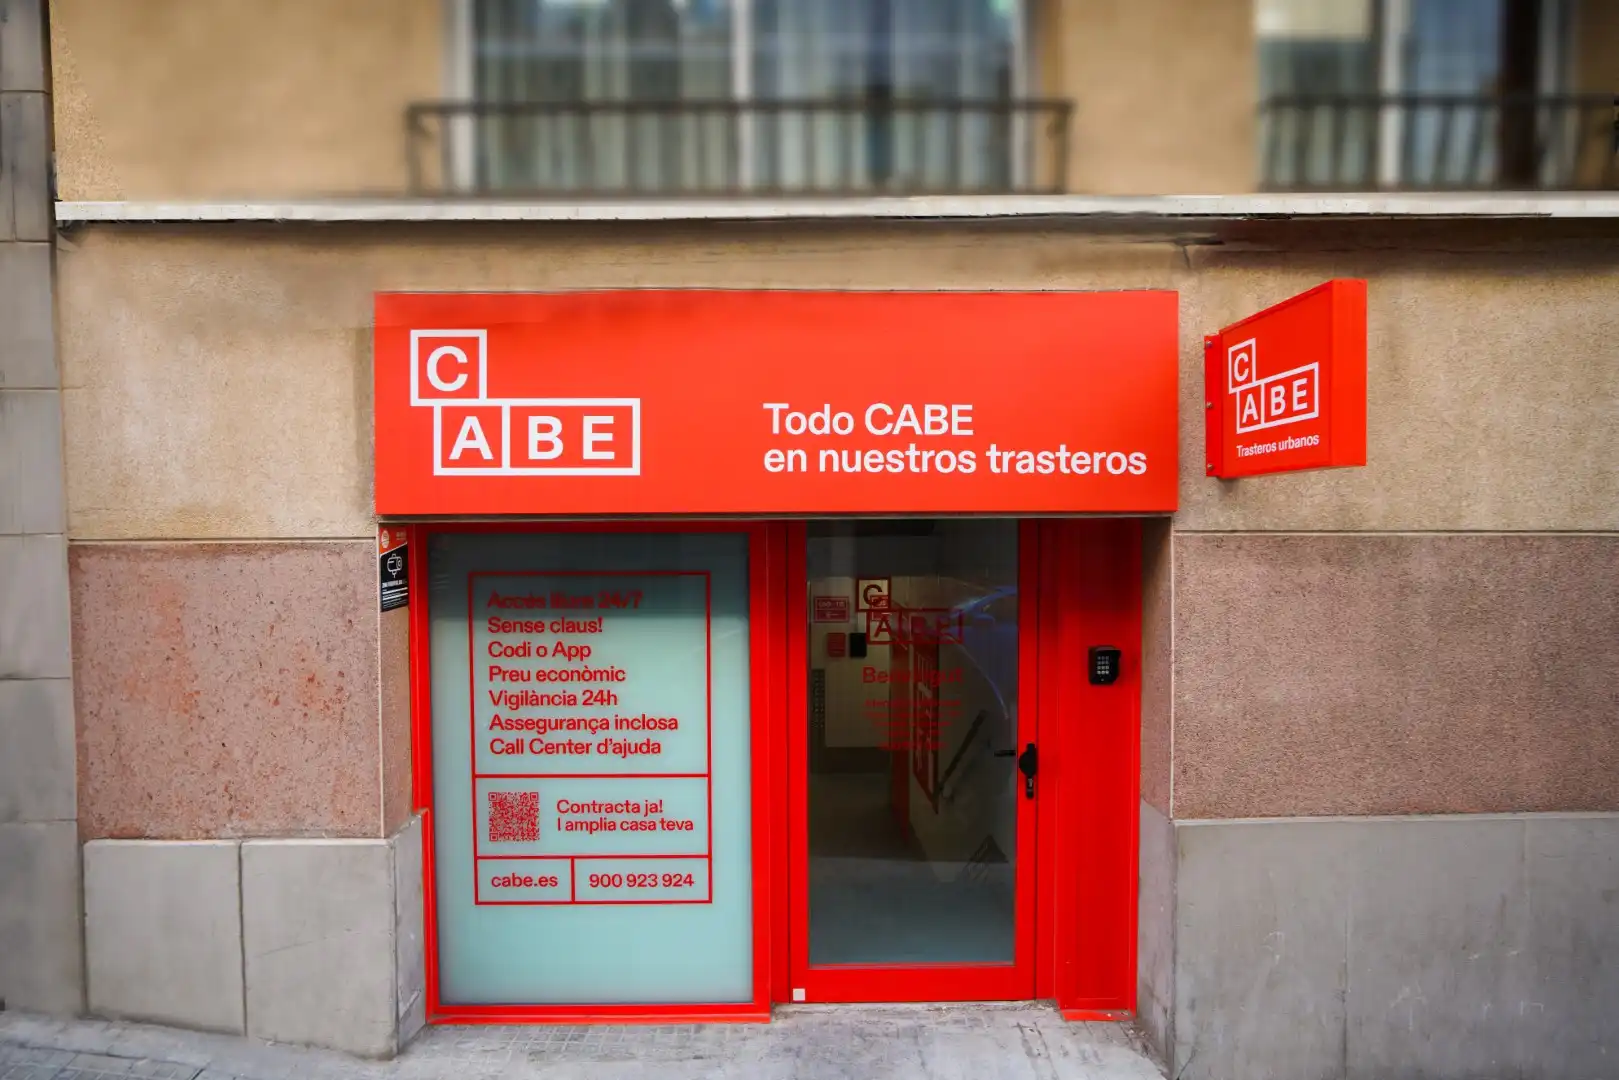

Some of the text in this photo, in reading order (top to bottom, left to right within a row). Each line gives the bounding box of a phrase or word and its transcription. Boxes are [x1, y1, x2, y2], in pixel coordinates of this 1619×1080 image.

[763, 403, 973, 435] Todo CABE
[1236, 434, 1320, 458] Trasteros urbanos
[764, 443, 1147, 475] en nuestros trasteros
[597, 590, 644, 609] 24/7
[488, 617, 604, 633] Sense claus!
[488, 641, 592, 661] Codi o App
[488, 665, 626, 682] Preu econòmic
[488, 689, 618, 711] Vigilància 24h
[489, 714, 679, 735] Assegurança inclosa
[490, 738, 524, 755] Call
[529, 738, 592, 755] Center
[556, 799, 663, 818] Contracta ja!
[565, 817, 616, 834] amplia
[620, 820, 657, 831] casa
[660, 818, 694, 831] teva
[491, 872, 558, 888] cabe.es
[588, 873, 695, 888] 900 923 924
